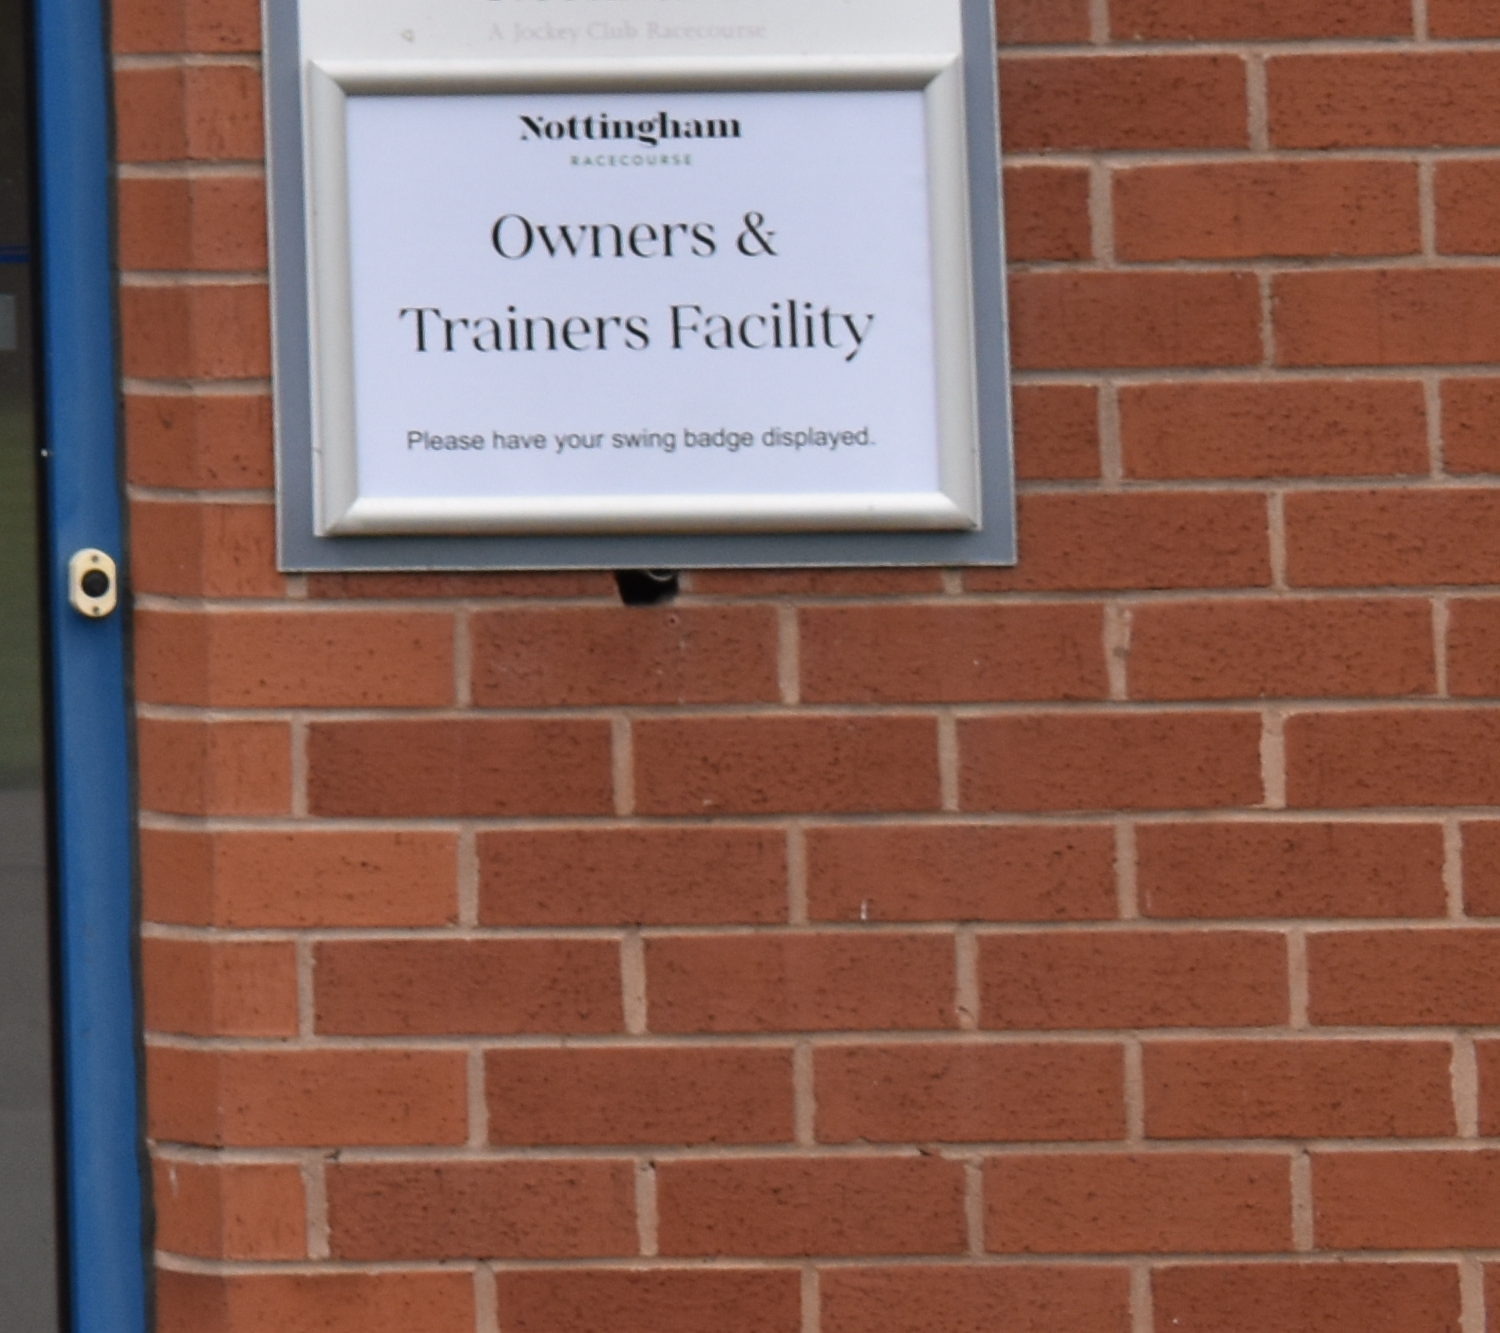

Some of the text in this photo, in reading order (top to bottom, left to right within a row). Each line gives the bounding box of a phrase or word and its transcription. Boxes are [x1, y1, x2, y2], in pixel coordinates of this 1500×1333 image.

[521, 112, 740, 146] Nottingham
[571, 154, 691, 166] RACECOURSE
[491, 213, 776, 258] Owners &
[400, 299, 874, 362] Trainers Facility
[407, 426, 876, 454] Please have your swing badge displayed.
